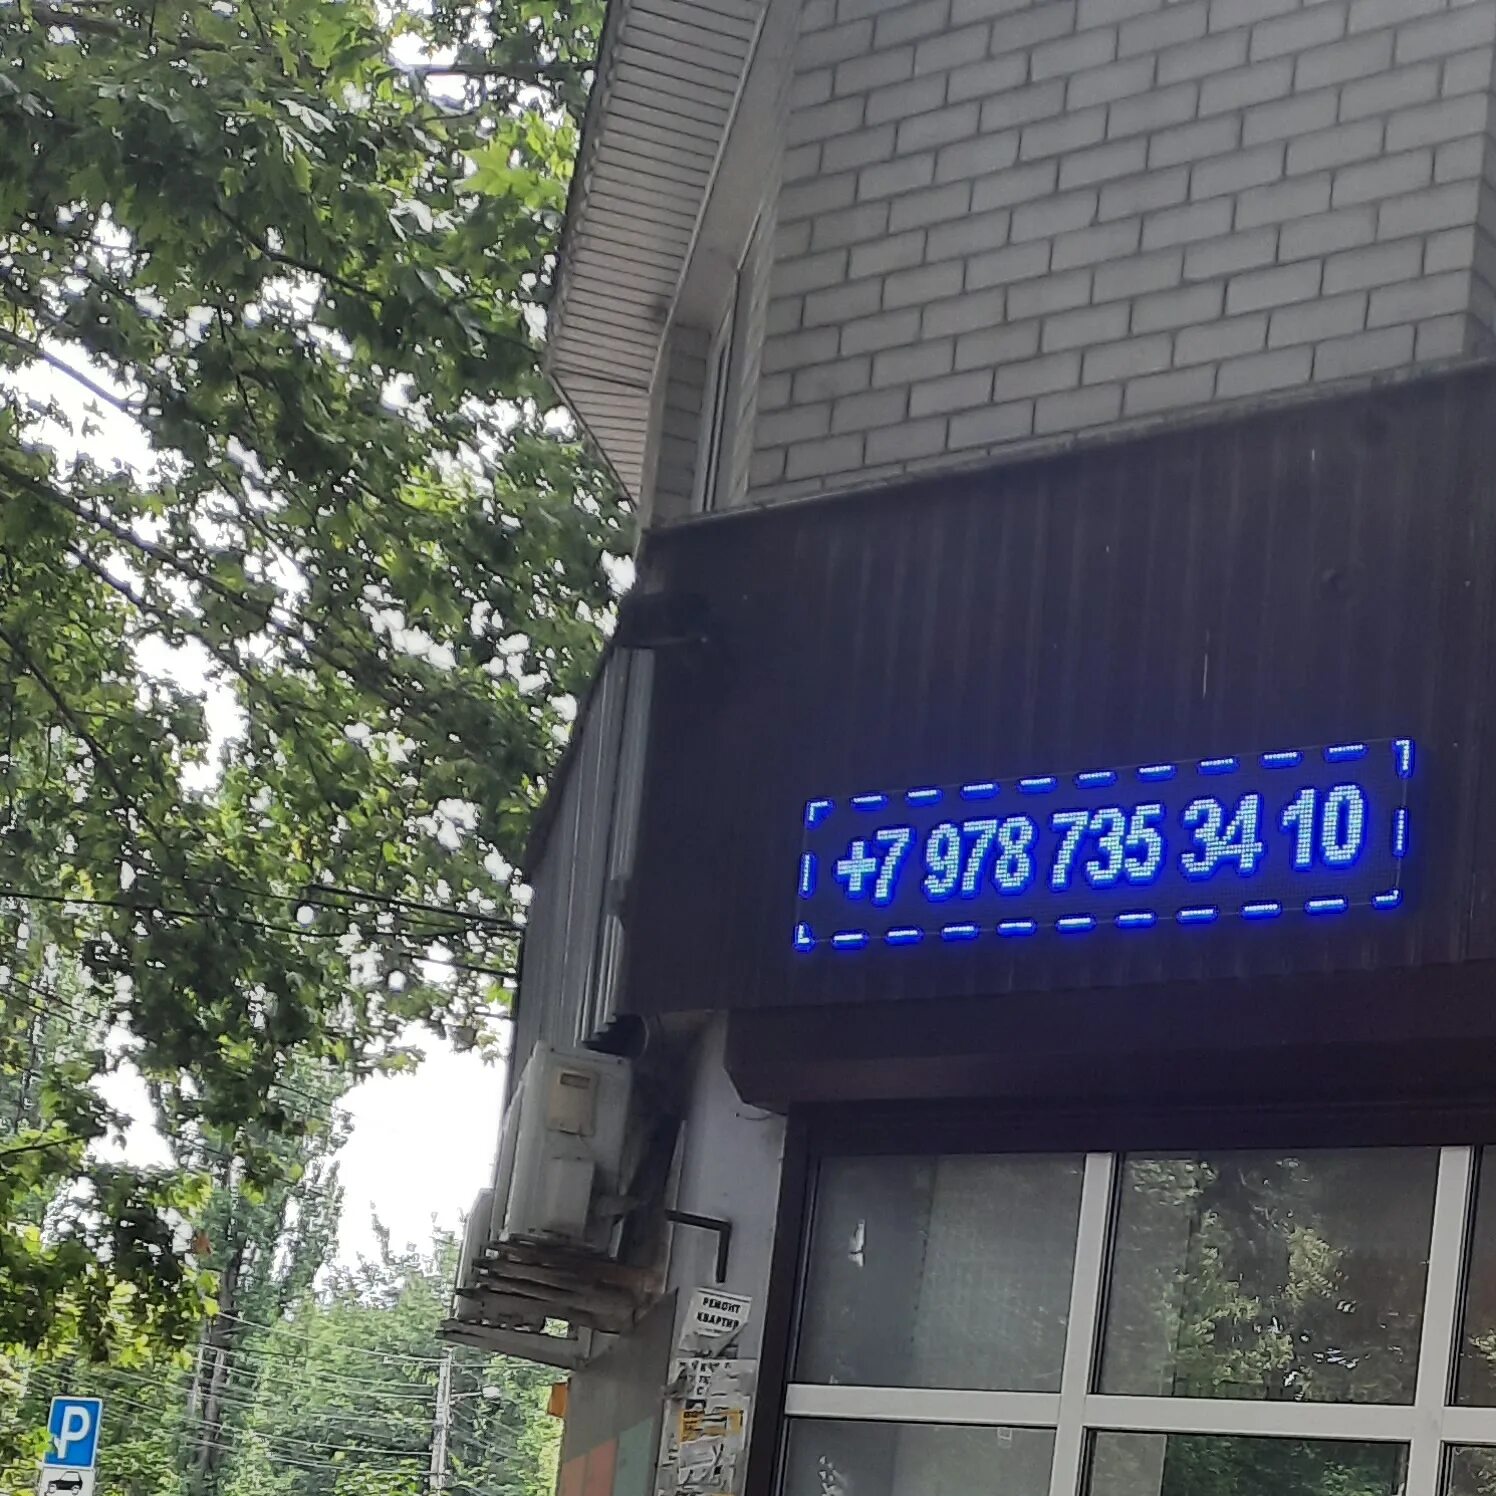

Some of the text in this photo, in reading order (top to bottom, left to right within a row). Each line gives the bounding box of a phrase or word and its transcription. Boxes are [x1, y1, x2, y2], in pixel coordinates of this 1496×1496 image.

[836, 783, 1363, 900] +7 978 735 34 10
